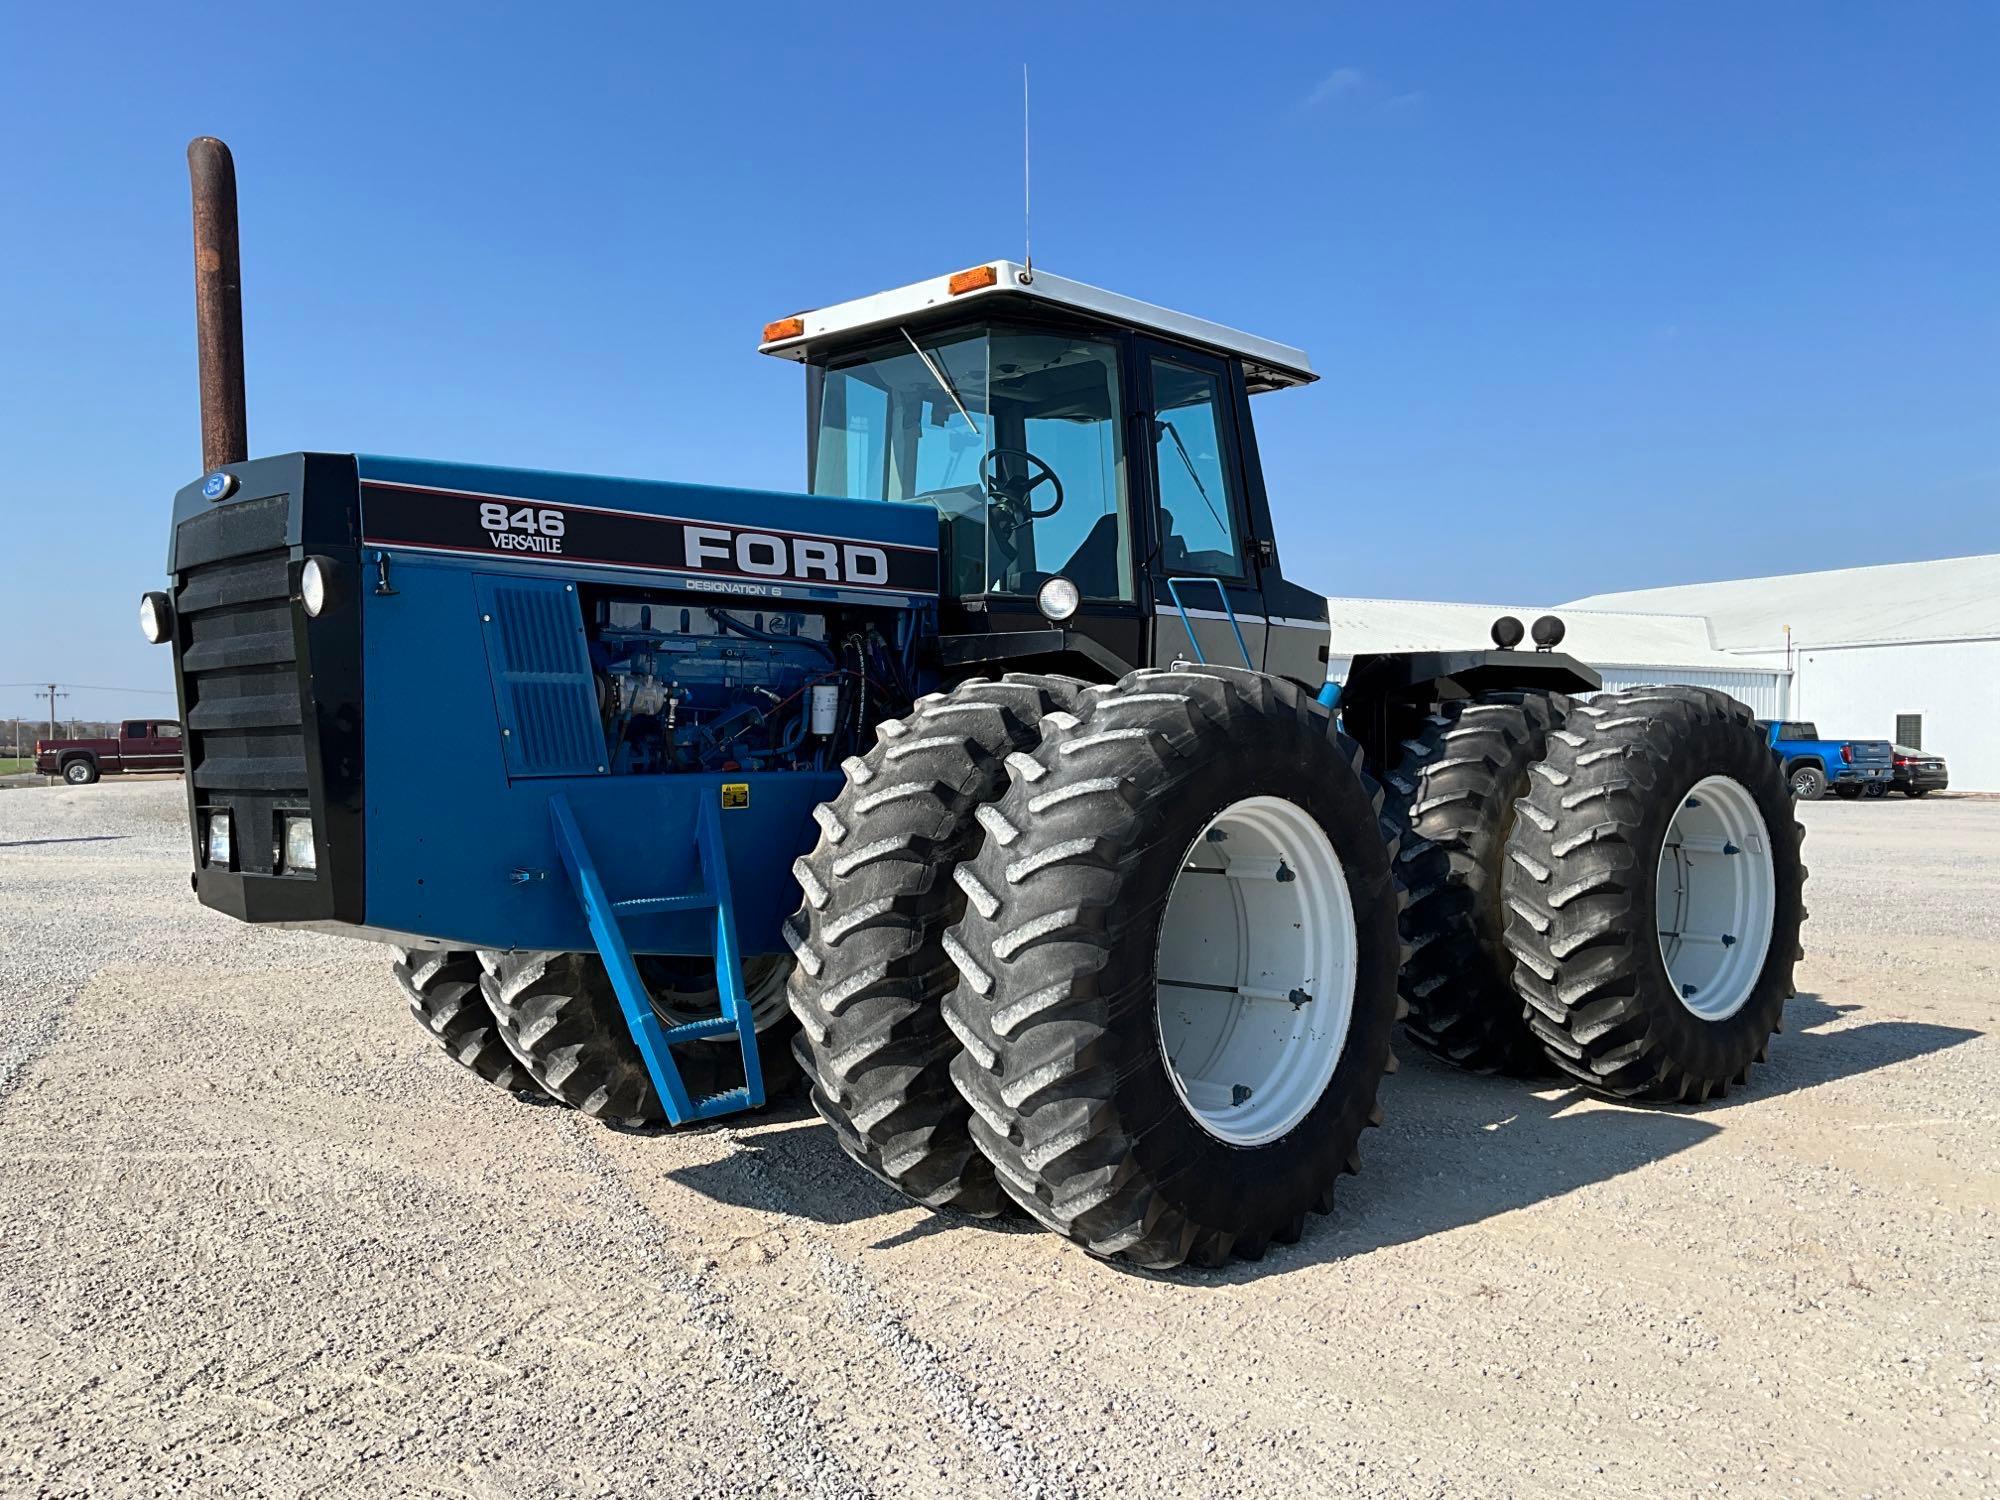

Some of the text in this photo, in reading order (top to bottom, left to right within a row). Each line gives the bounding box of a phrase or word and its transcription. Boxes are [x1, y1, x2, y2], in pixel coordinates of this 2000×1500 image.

[480, 502, 565, 537] 846
[489, 531, 562, 554] VERSATILE
[683, 525, 889, 585] FORD
[686, 579, 782, 596] DESIGNATION 6
